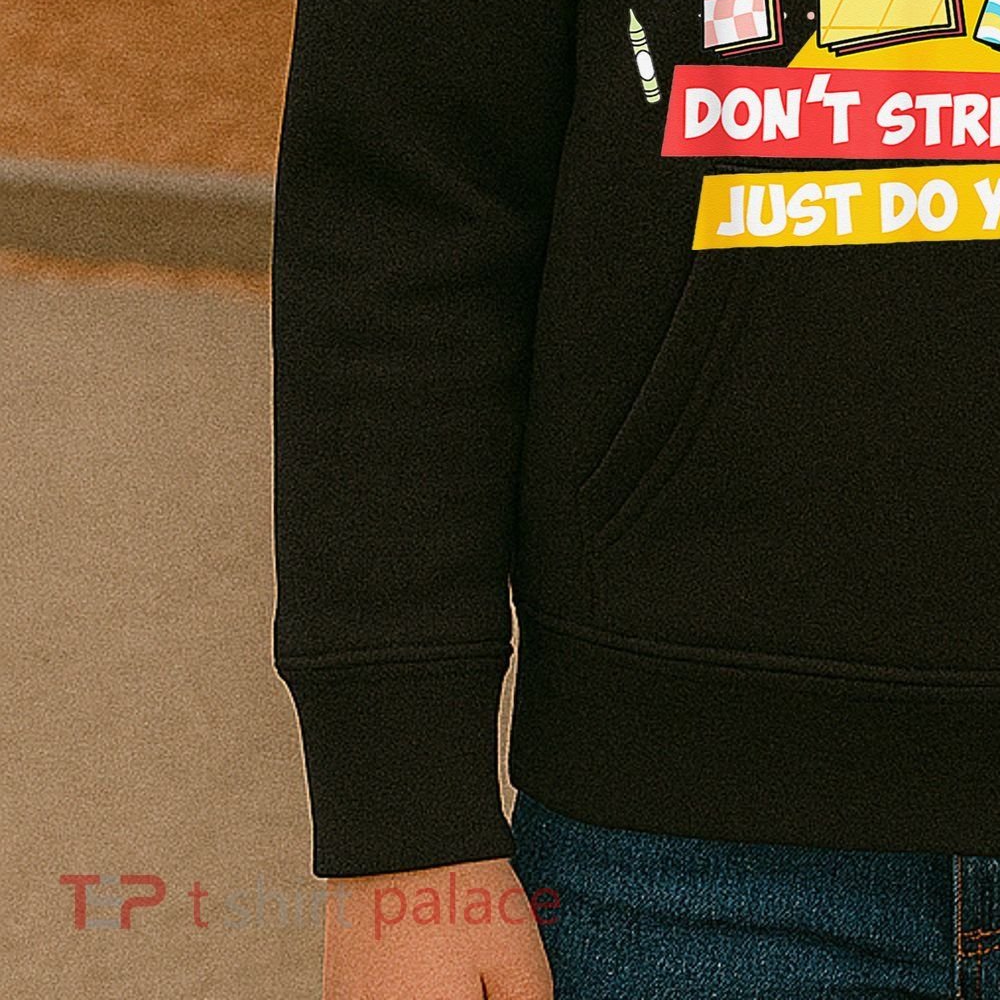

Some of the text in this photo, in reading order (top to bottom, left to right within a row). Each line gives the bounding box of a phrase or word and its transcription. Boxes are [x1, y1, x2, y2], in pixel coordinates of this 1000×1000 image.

[684, 73, 861, 146] DON'T
[716, 182, 862, 236] JUST
[880, 179, 959, 232] DO
